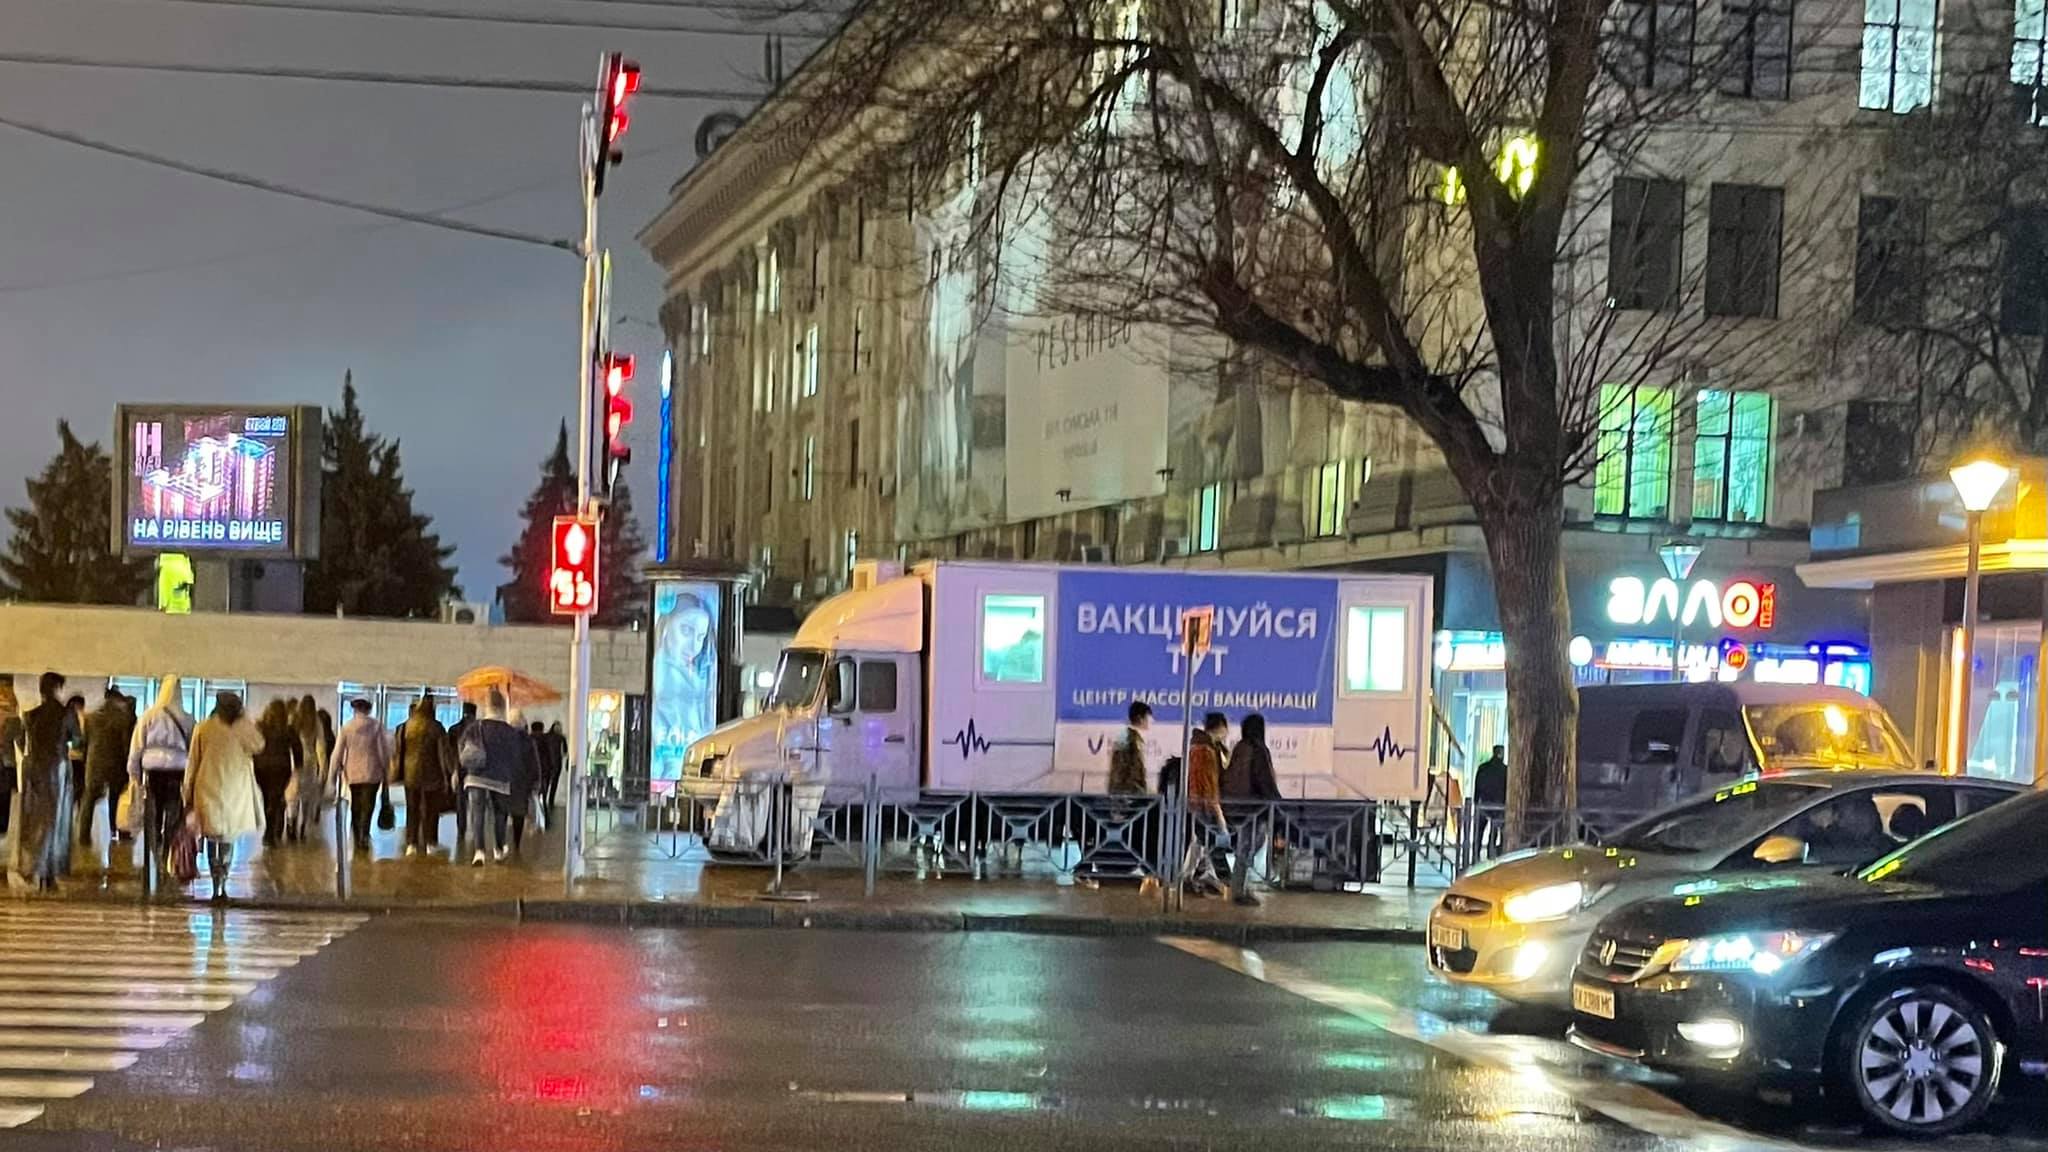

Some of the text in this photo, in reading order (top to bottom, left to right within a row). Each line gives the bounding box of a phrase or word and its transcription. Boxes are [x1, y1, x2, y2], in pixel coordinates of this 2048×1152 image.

[133, 518, 282, 543] НА РІВЕНЬ ВИЩЕ
[1077, 601, 1317, 639] ВАКЦНУЙСЯ
[1165, 645, 1229, 677] ТУТ
[1072, 688, 1127, 707] ЦЕНТР
[1213, 689, 1318, 711] ВАКЦИНАЦІЇ
